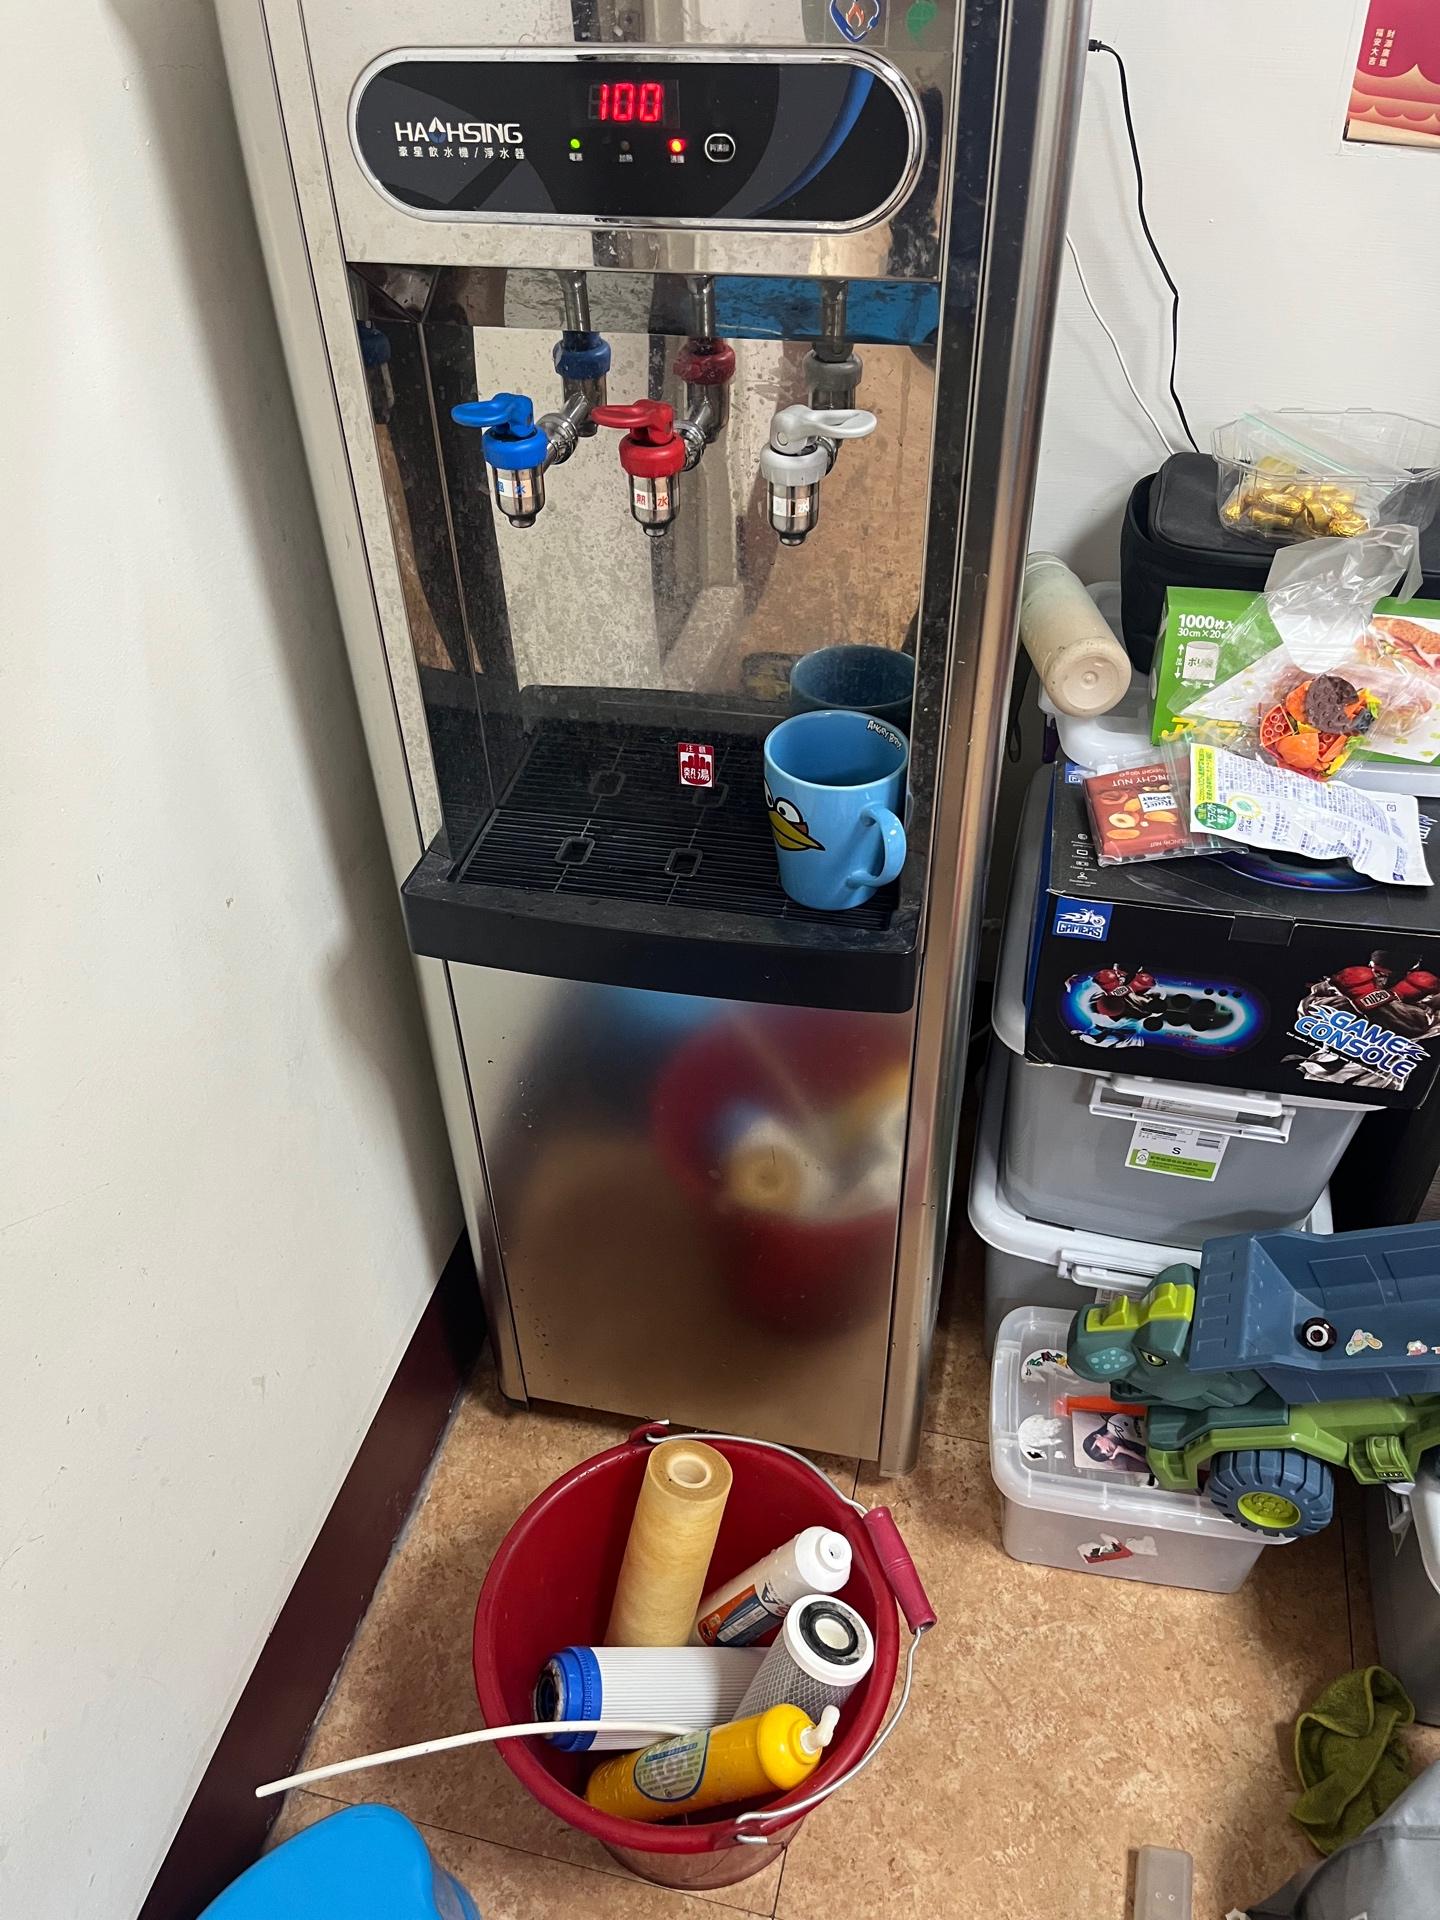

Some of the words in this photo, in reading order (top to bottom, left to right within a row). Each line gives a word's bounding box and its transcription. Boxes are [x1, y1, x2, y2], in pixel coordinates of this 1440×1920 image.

[600, 82, 662, 122] 100
[636, 493, 668, 507] 熱水
[1112, 778, 1133, 787] NUT
[1058, 921, 1102, 938] GAMERS
[1329, 1010, 1408, 1056] GAME
[1294, 1015, 1417, 1080] CONSOLE
[1171, 1147, 1182, 1155] S
